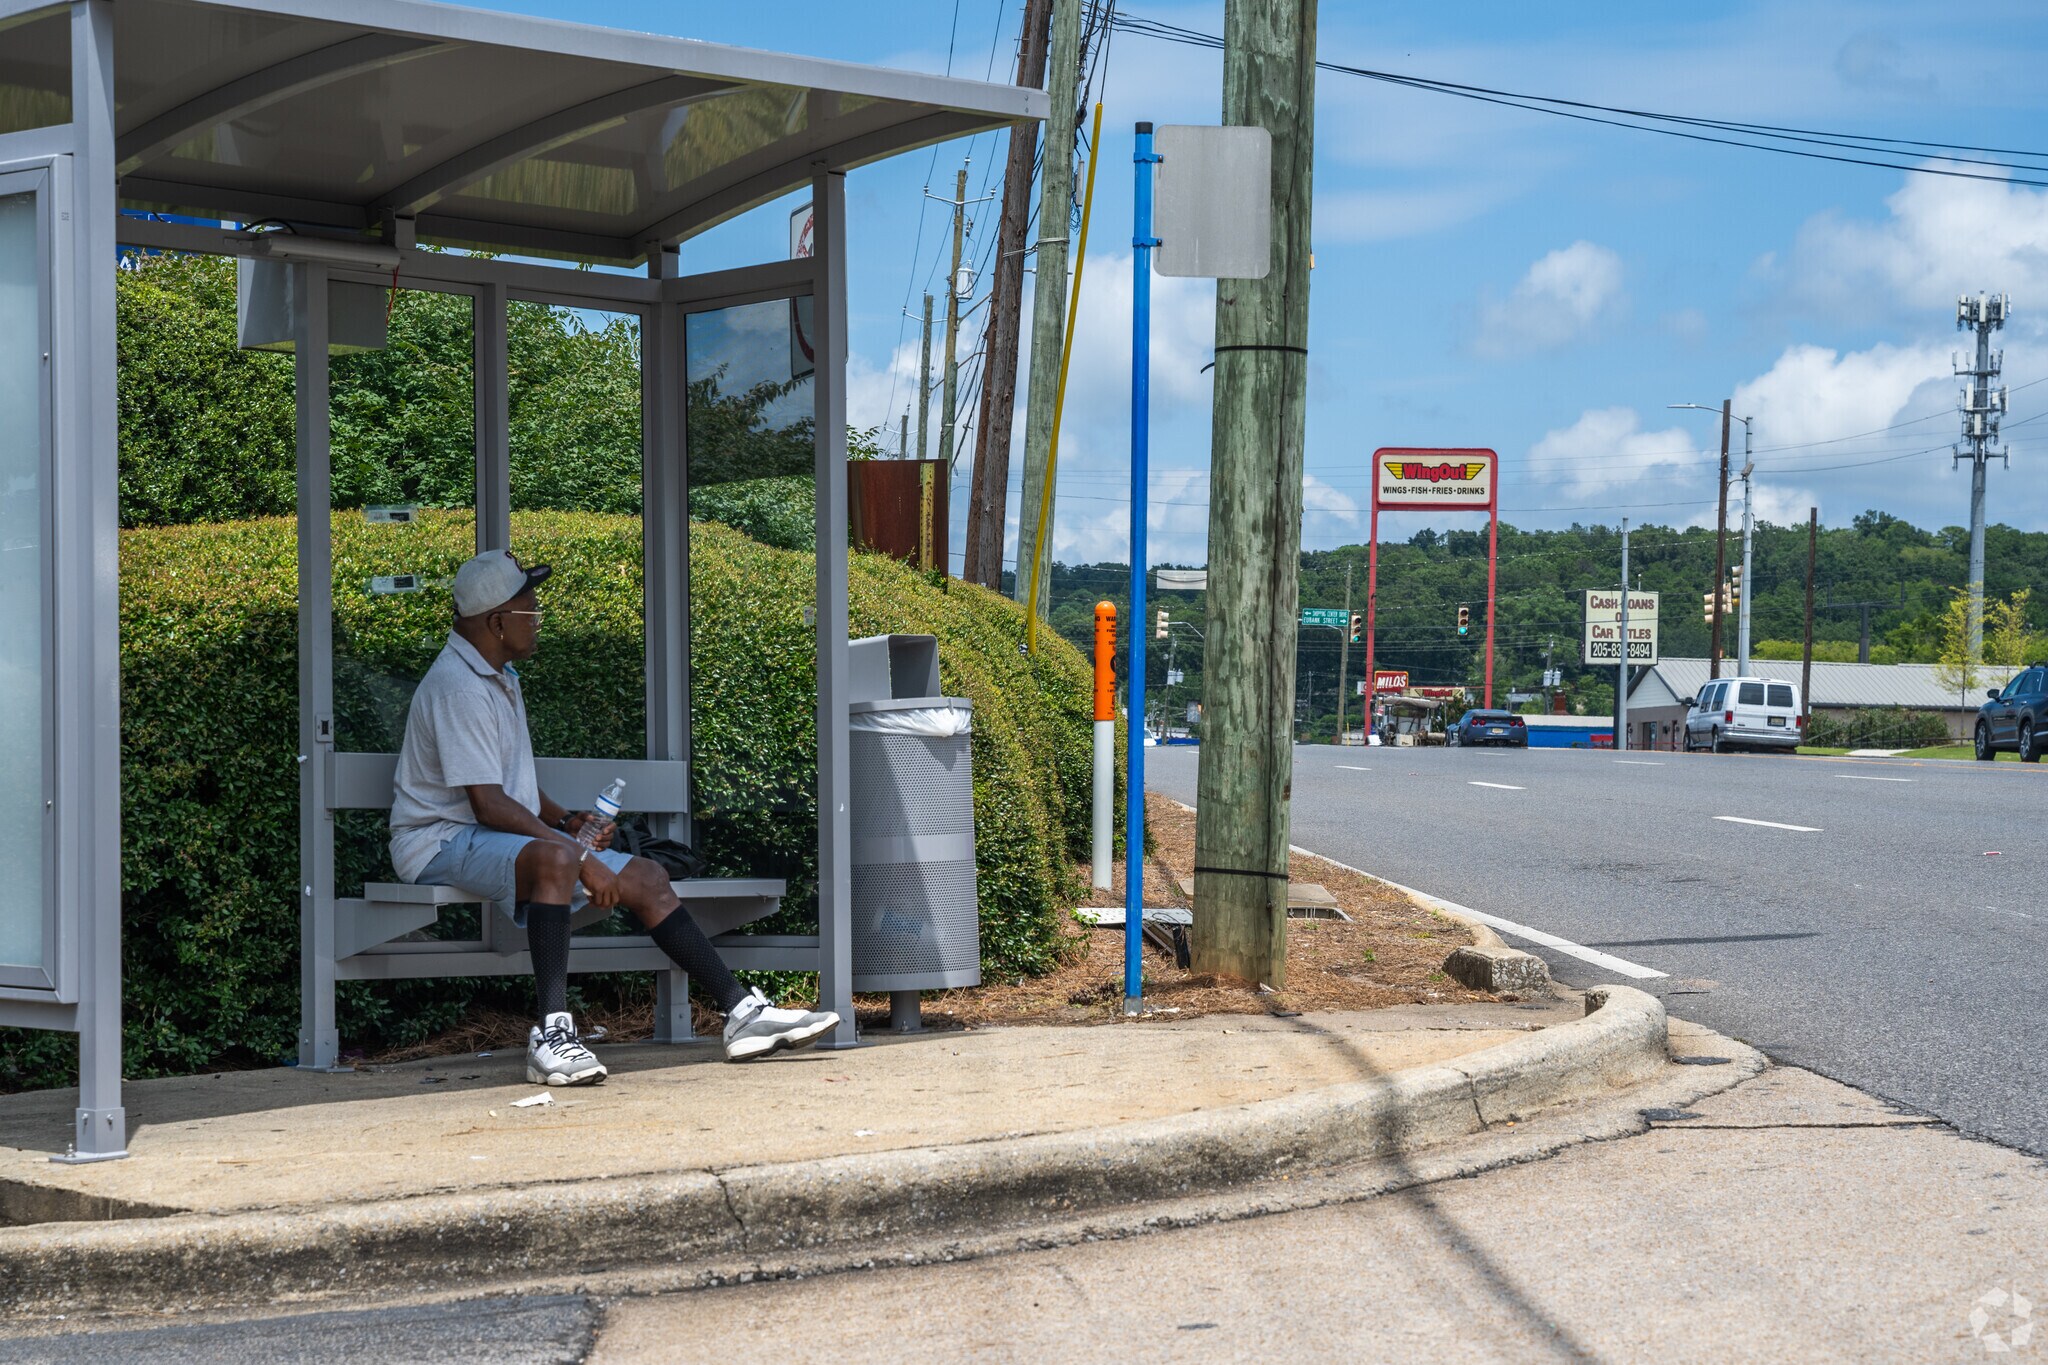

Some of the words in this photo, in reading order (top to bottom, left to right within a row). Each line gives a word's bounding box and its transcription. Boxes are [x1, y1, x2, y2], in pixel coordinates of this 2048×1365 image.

[1382, 486, 1407, 494] WINGS
[1411, 486, 1428, 494] FISH
[1432, 487, 1453, 495] FRIES
[1457, 487, 1485, 495] DRINKS
[1590, 595, 1618, 609] CASH
[1624, 597, 1655, 610] OANS
[1591, 625, 1614, 639] CAR
[1616, 625, 1652, 640] TTLES
[1592, 642, 1651, 657] 205-83-8494
